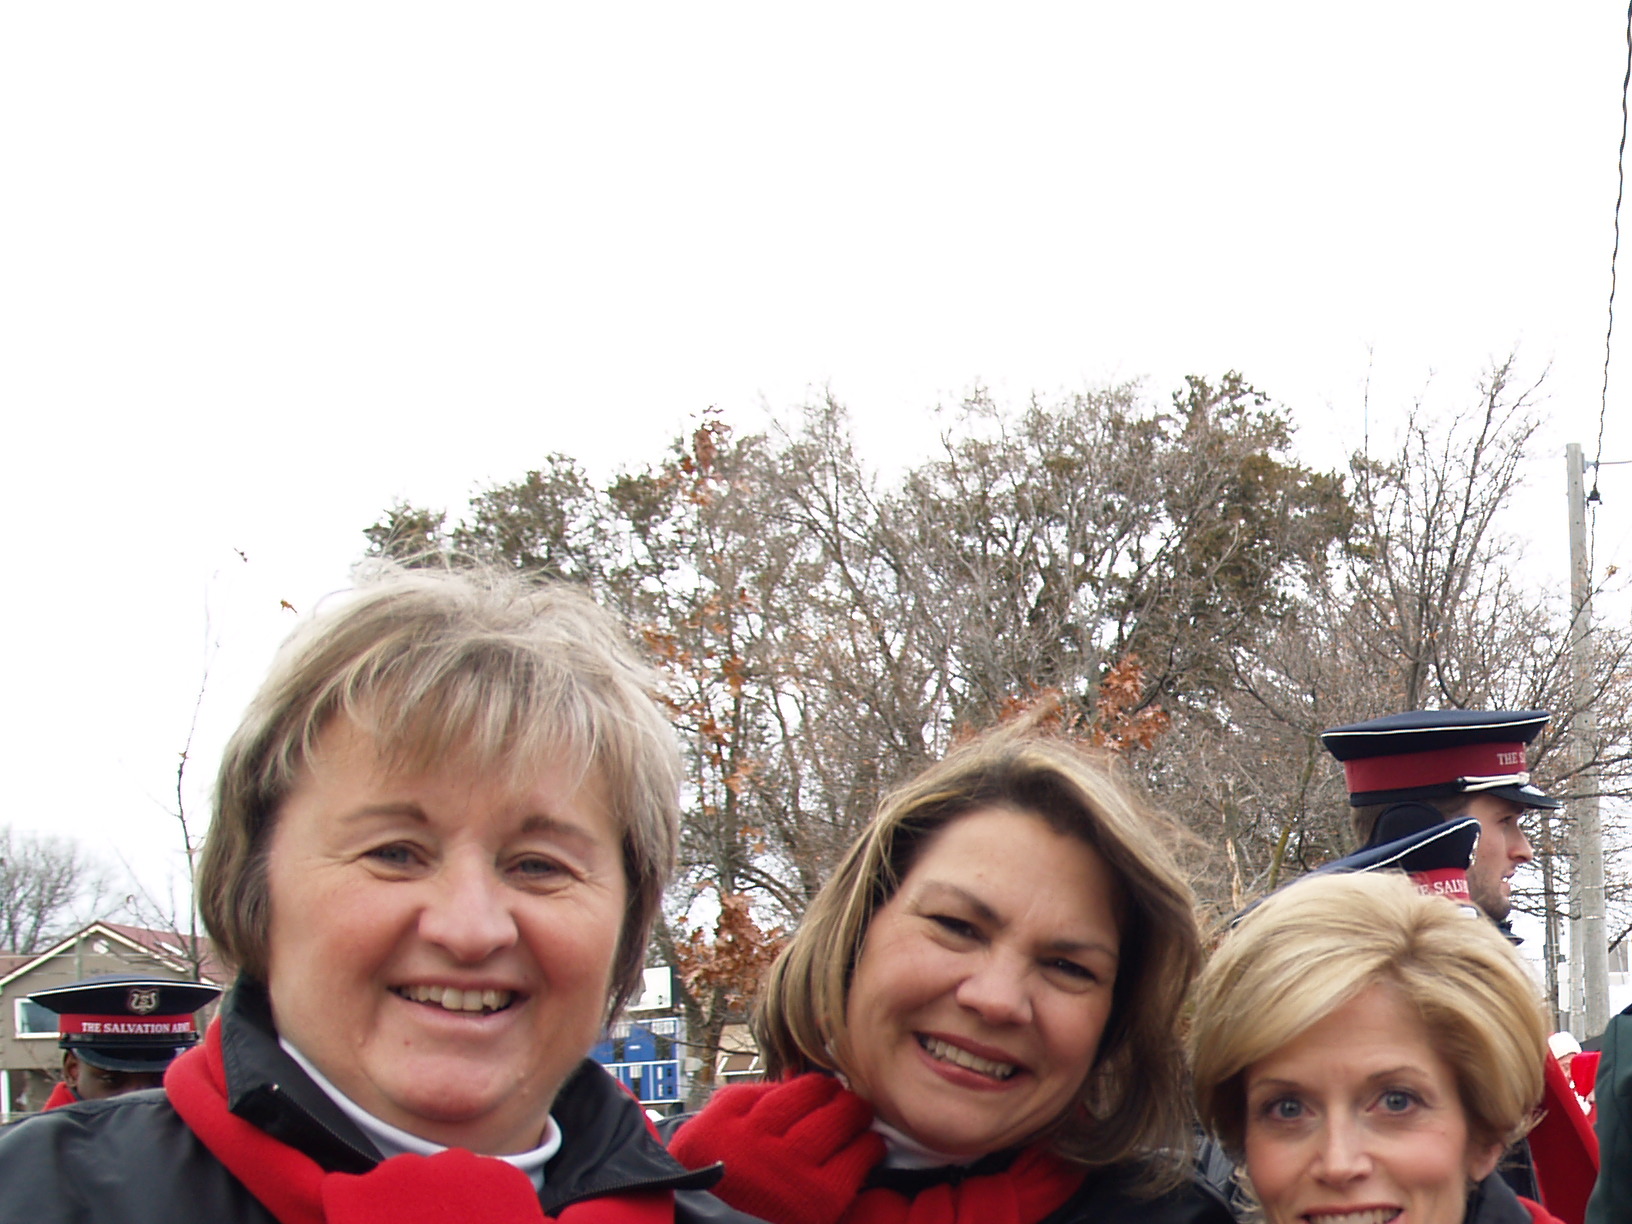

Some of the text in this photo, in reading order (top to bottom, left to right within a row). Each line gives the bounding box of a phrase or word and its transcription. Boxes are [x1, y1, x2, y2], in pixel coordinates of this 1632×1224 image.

[1497, 752, 1518, 766] THE
[81, 1022, 102, 1033] THE
[104, 1022, 170, 1034] SALVATION
